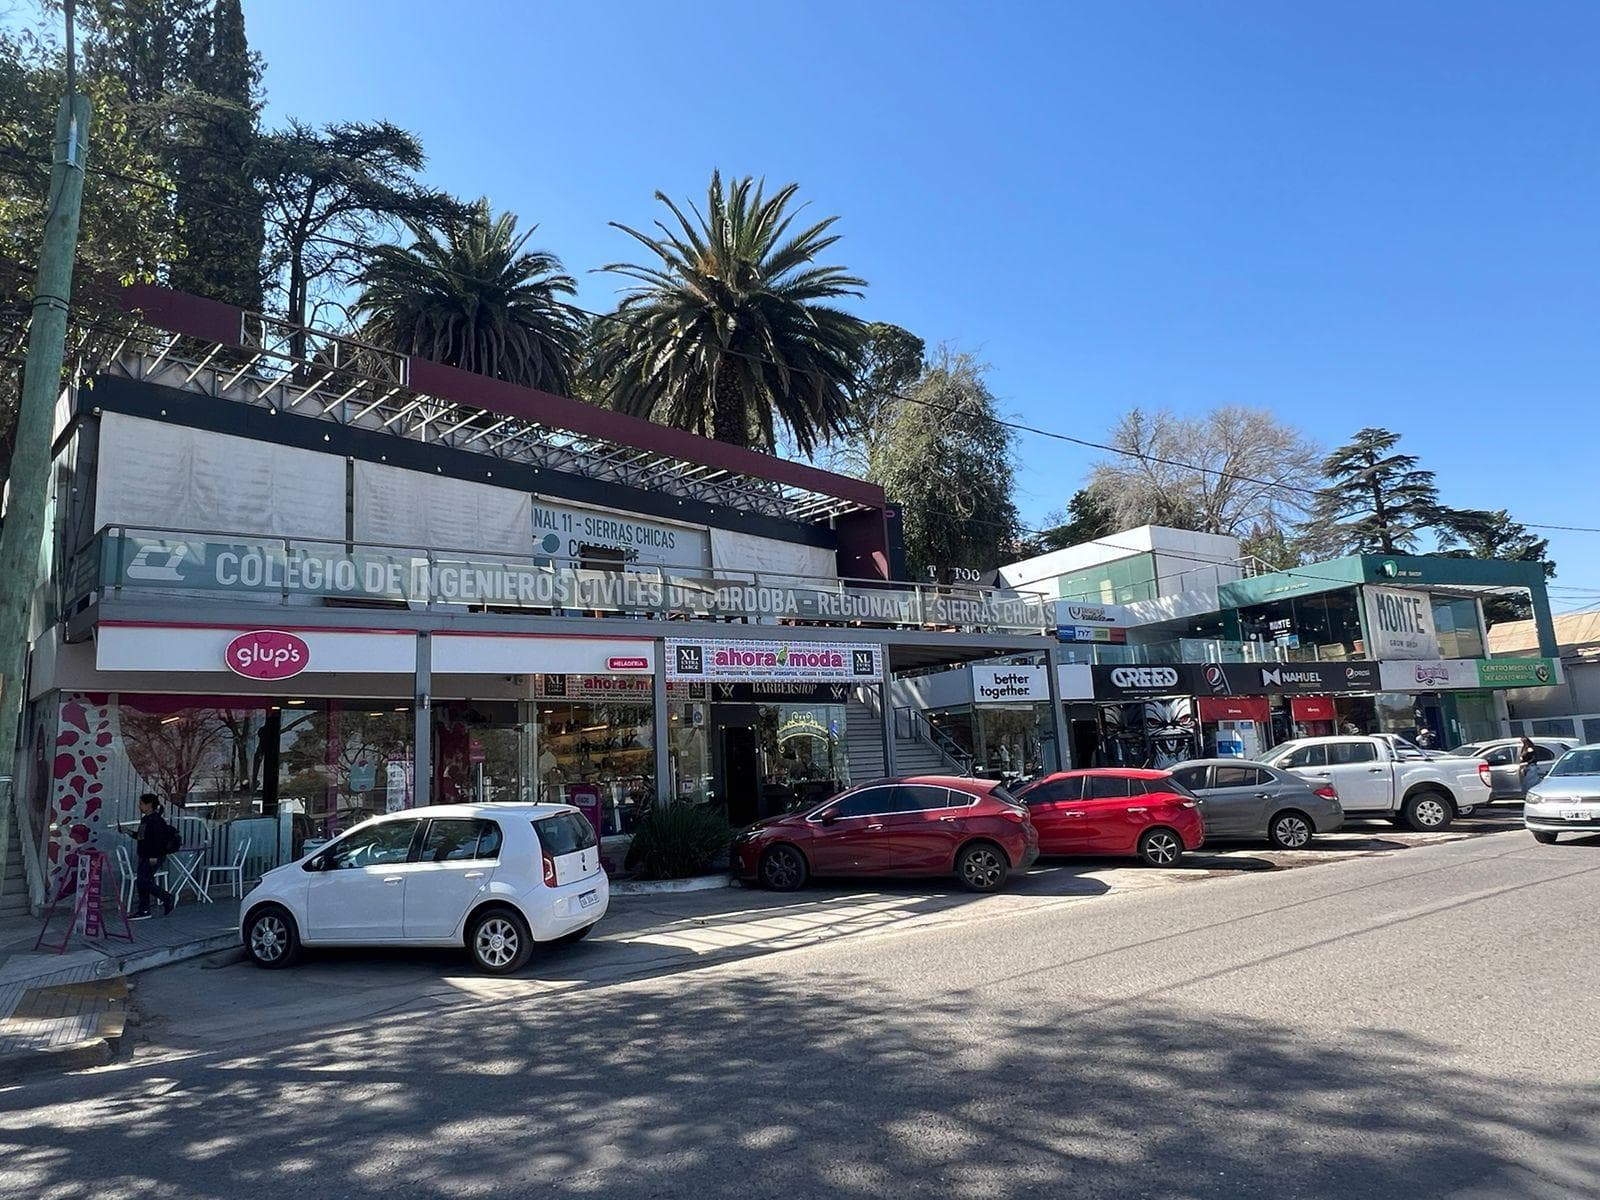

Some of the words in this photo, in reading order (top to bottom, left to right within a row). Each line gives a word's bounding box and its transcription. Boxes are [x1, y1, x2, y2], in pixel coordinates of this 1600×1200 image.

[531, 508, 559, 531] NAL
[562, 513, 573, 533] 11
[585, 517, 633, 543] SIERRAS
[636, 526, 675, 550] CHICAS
[216, 552, 356, 591] COLEGIO
[365, 561, 402, 594] DE
[412, 565, 569, 602] INGENIEROS
[578, 578, 662, 608] CIVILES
[670, 585, 696, 609] DE
[936, 599, 1000, 623] SIERRAS
[1003, 602, 1055, 626] CHICAS
[236, 643, 301, 668] glup's
[680, 649, 699, 661] XL
[715, 648, 777, 667] ahora
[788, 650, 843, 668] moda
[856, 653, 871, 664] XL
[584, 676, 627, 690] ahora
[993, 673, 1030, 685] better
[1282, 672, 1322, 683] NAHUEL
[980, 685, 1030, 700] together.
